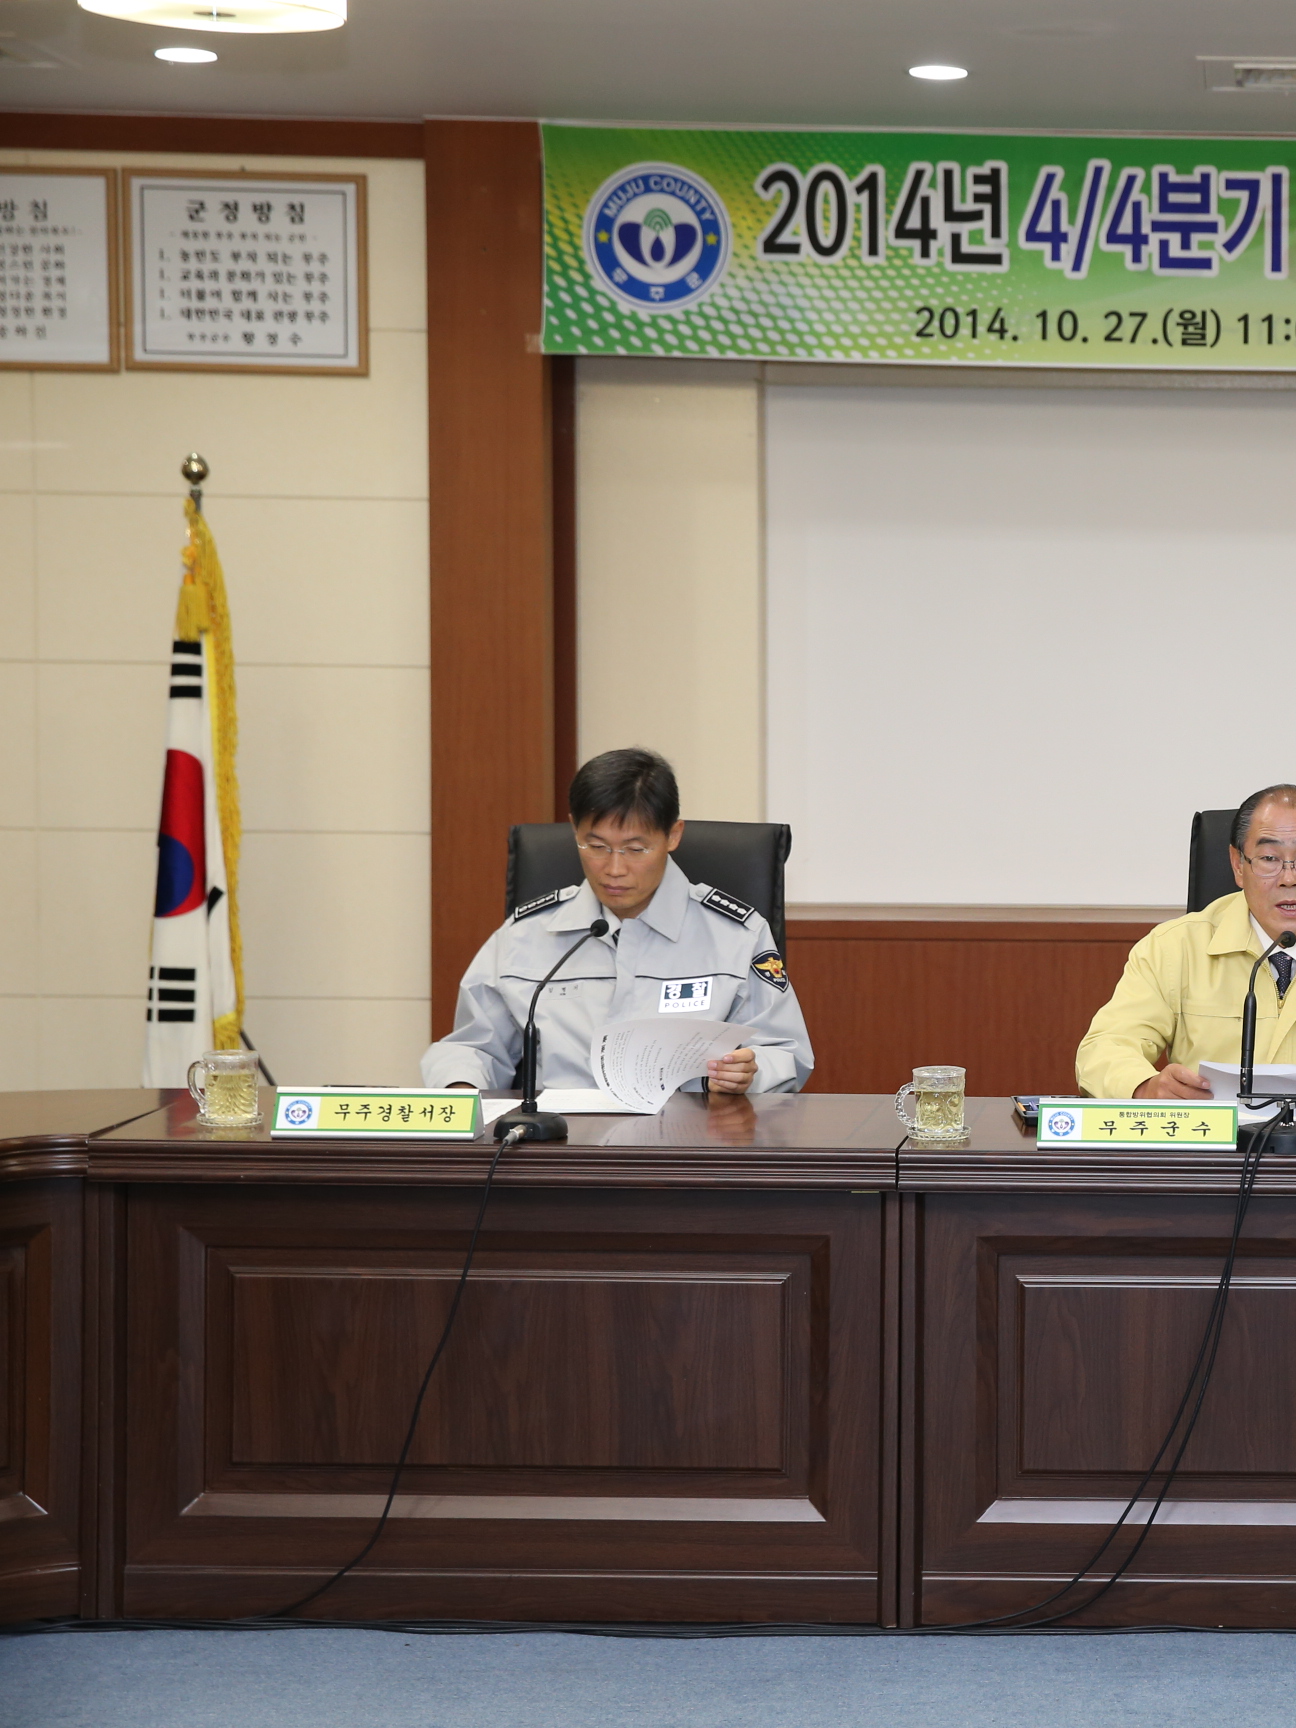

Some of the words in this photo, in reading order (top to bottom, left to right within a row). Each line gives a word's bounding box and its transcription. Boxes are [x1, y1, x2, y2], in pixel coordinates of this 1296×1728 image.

[603, 177, 645, 218] MUJU
[649, 176, 715, 221] COUNTY
[186, 199, 306, 225] 군정방침
[761, 165, 1002, 266] 2014년
[1025, 165, 1284, 272] 4/4분기
[914, 306, 1020, 342] 2014.
[1035, 309, 1090, 344] 10.
[1103, 307, 1222, 348] 27.(월)
[665, 982, 707, 1000] 경찰
[664, 999, 706, 1009] POLICE
[333, 1103, 457, 1123] 무주경찰서장
[1169, 1111, 1190, 1119] 위원장
[1097, 1120, 1212, 1138] 무주군수
